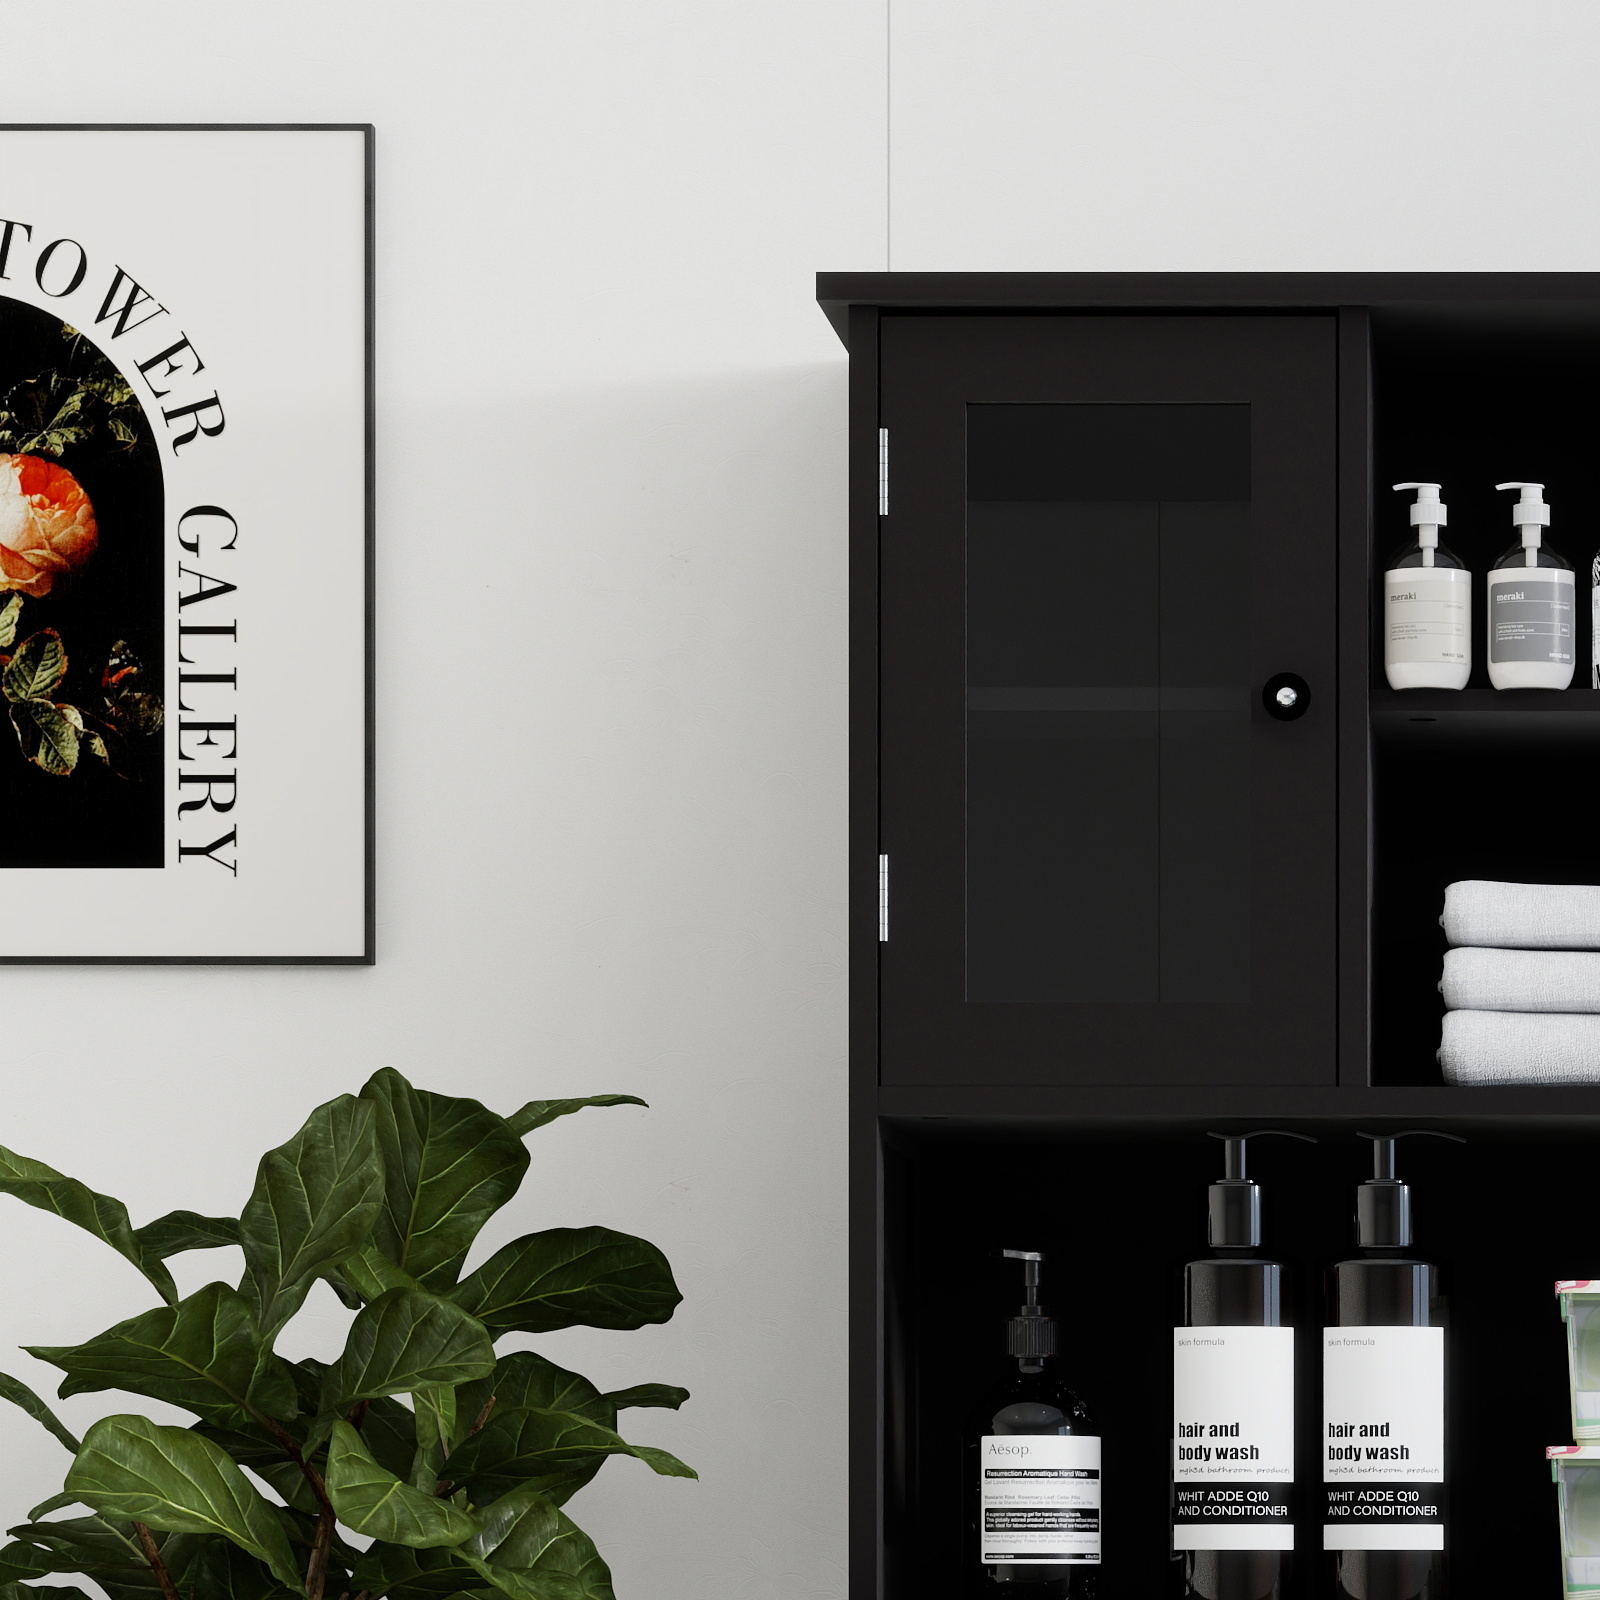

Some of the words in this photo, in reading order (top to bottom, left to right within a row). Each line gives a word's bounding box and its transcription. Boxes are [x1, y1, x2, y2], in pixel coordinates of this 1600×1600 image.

[1390, 592, 1417, 602] meraki
[1496, 592, 1525, 602] meraki
[177, 505, 238, 877] GALLERY
[1178, 1338, 1192, 1346] skin
[1193, 1338, 1225, 1346] formula
[1328, 1338, 1342, 1346] skin
[1343, 1338, 1375, 1346] formula
[1178, 1422, 1205, 1438] hair
[1208, 1422, 1240, 1438] and
[1328, 1422, 1355, 1438] hair
[1358, 1422, 1390, 1438] and
[1178, 1445, 1211, 1462] body
[1215, 1445, 1260, 1460] wash
[1328, 1445, 1361, 1462] body
[1365, 1445, 1410, 1460] wash
[1207, 1466, 1253, 1474] bathroom
[1357, 1466, 1403, 1474] bathroom
[1178, 1491, 1205, 1502] WHIT
[1207, 1491, 1244, 1502] ADDE
[1246, 1491, 1270, 1502] Q10
[1328, 1491, 1355, 1502] WHIT
[1357, 1491, 1394, 1502] ADDE
[1396, 1491, 1420, 1502] Q10
[1178, 1505, 1200, 1516] AND
[1202, 1505, 1288, 1516] CONDITIONER
[1328, 1505, 1350, 1516] AND
[1352, 1505, 1438, 1516] CONDITIONER
